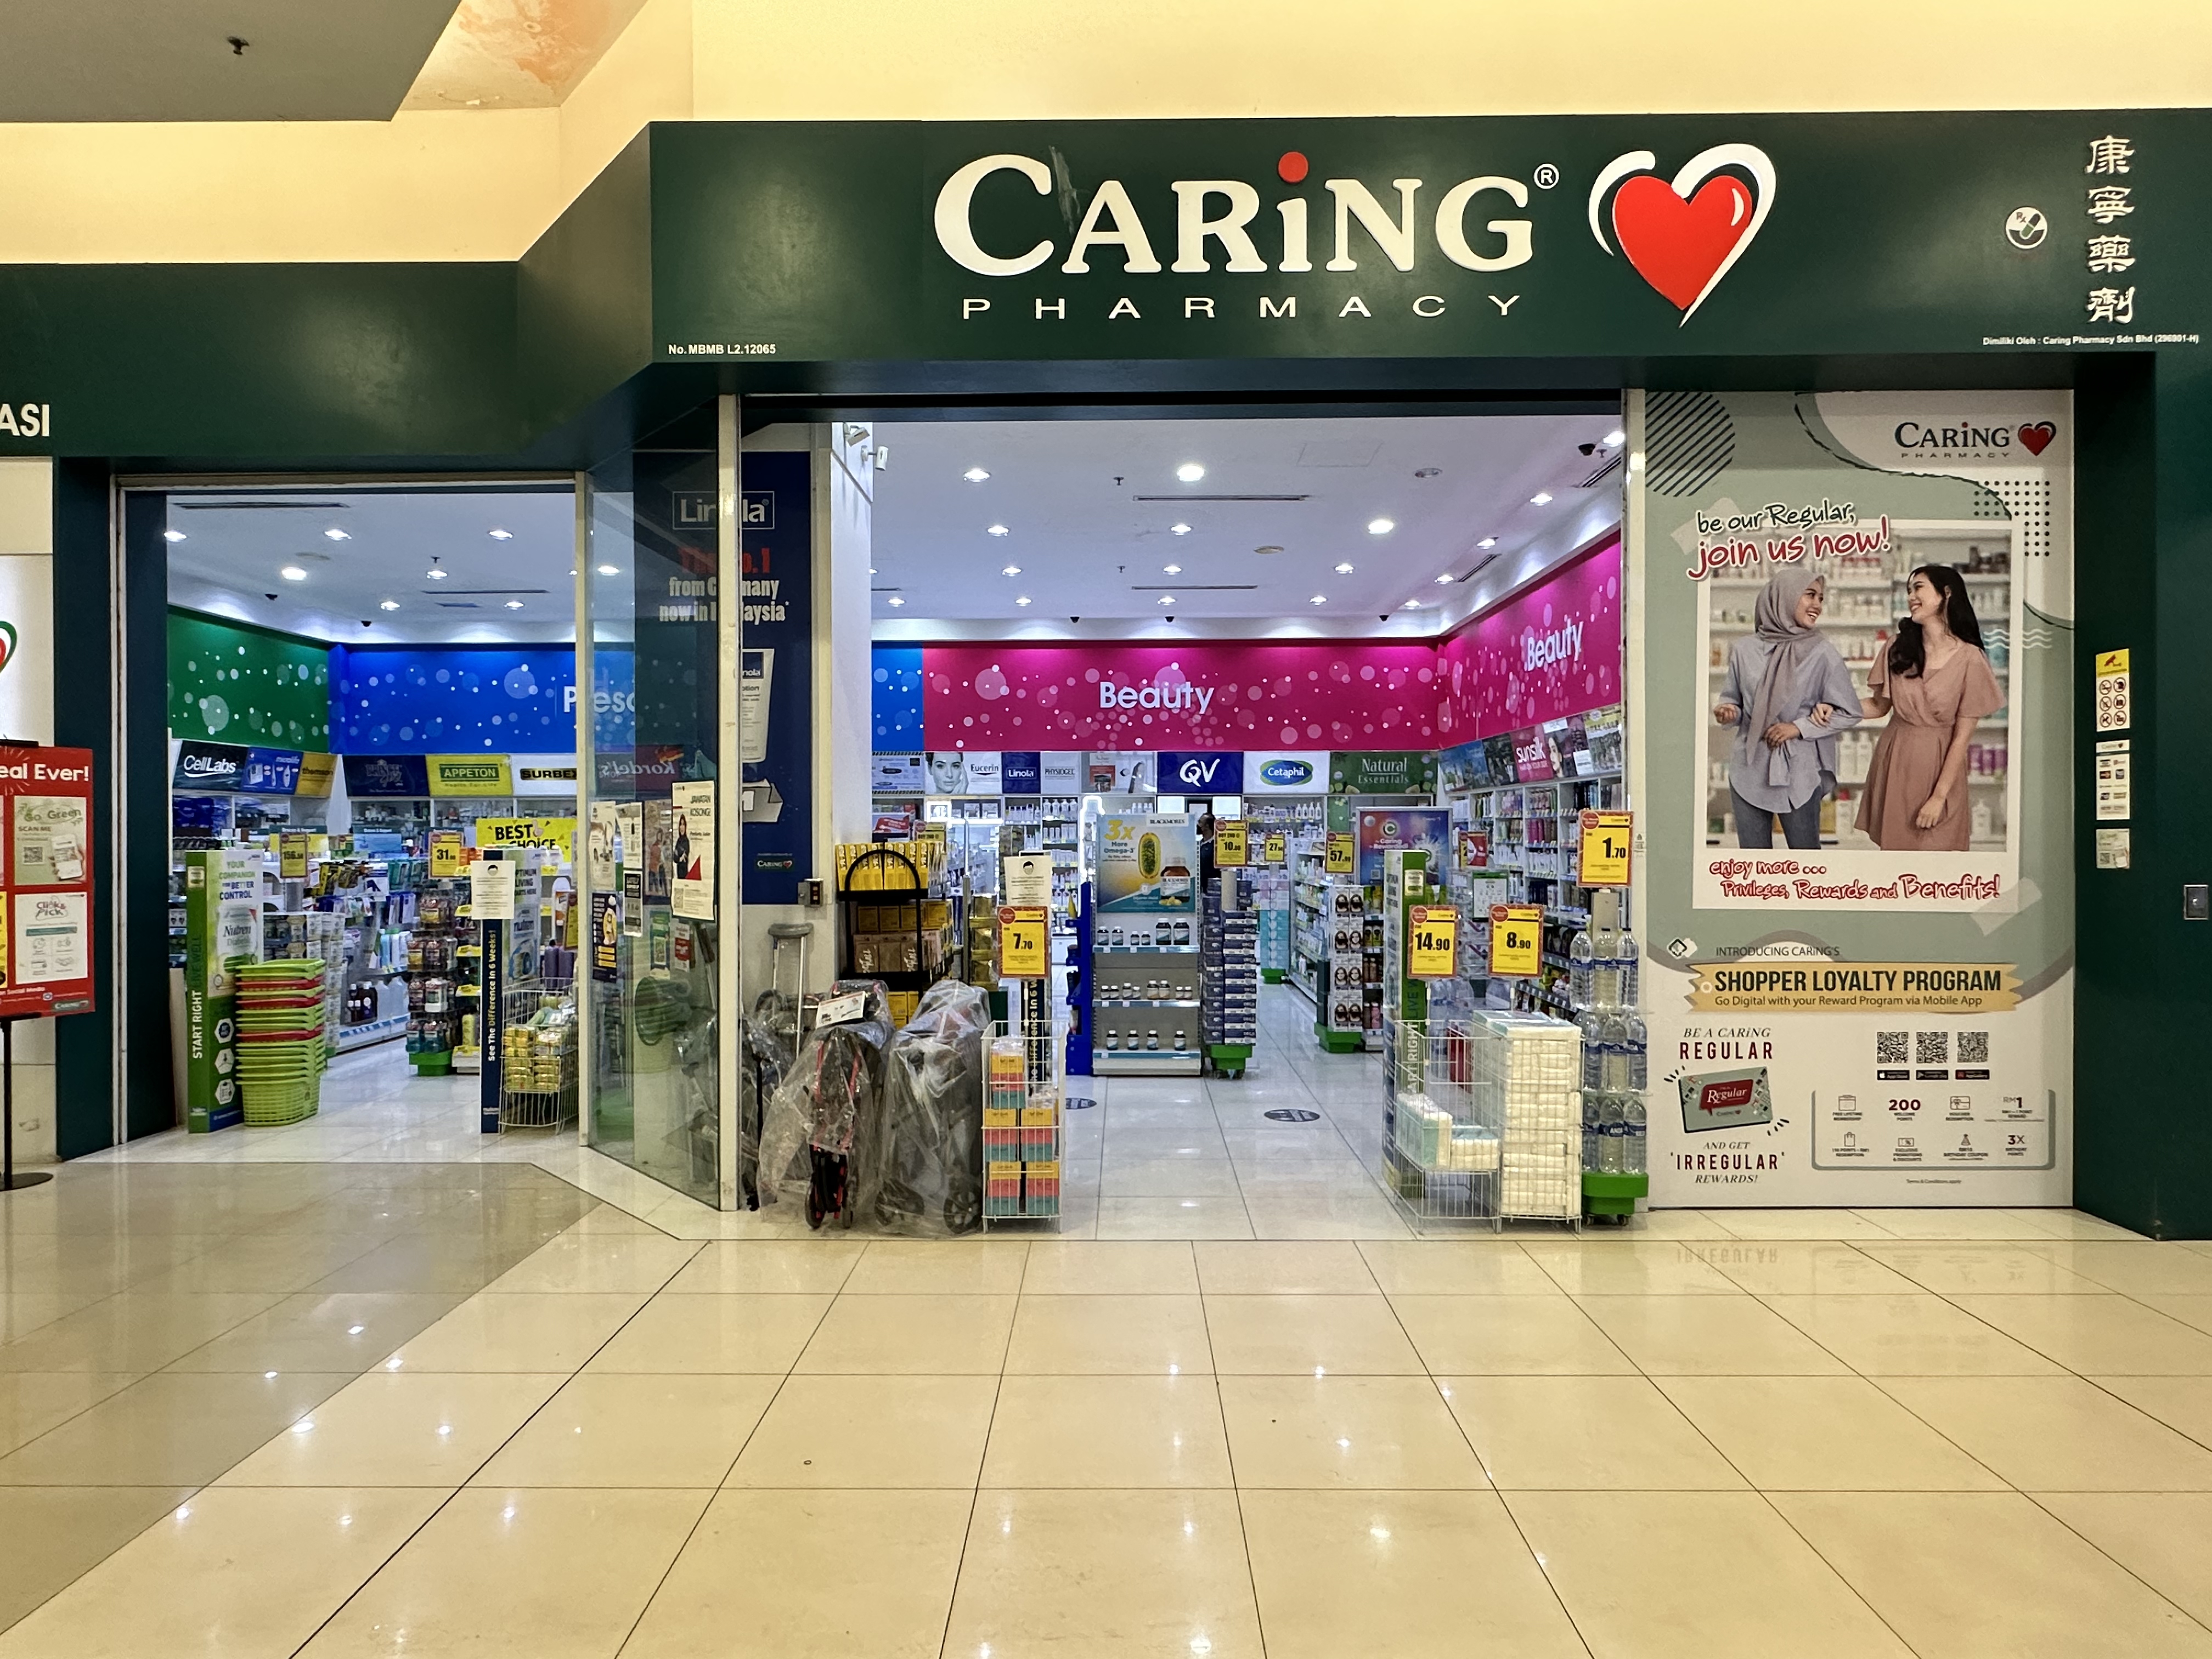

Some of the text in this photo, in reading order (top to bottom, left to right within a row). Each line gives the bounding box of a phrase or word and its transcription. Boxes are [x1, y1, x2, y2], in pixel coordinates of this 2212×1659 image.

[963, 295, 1521, 319] PHARMACY
[668, 344, 776, 354] No. MBMB L2.12065
[1983, 337, 2014, 345] Dimiliki
[2043, 336, 2070, 346] Caring
[2073, 335, 2114, 345] Pharmacy
[2117, 335, 2133, 343] Sdn
[2135, 335, 2153, 343] Bhd
[1697, 499, 1855, 533] be our Regular,
[1688, 516, 1890, 578] join us now!
[669, 577, 780, 600] from Gmany
[659, 601, 786, 625] now in aysia
[1527, 618, 1584, 672] Beauty
[1100, 681, 1215, 714] Beauty
[34, 764, 89, 781] Ever!
[444, 768, 496, 777] APPETON
[1180, 758, 1220, 787] QV
[1268, 766, 1305, 778] Cetaphil
[1362, 757, 1407, 772] Natural
[1358, 775, 1409, 783] Essentials
[24, 808, 81, 822] Go Green
[495, 824, 533, 840] BEST
[1104, 819, 1136, 840] 3x
[1602, 837, 1626, 859] 1.70
[1709, 859, 1753, 879] enjoy
[1756, 860, 1799, 874] more
[219, 890, 252, 900] CONTROL
[1720, 873, 2000, 900] Privileges, Rewards and Benefits!
[487, 930, 496, 962] Weeks!
[1013, 933, 1032, 950] 7.70
[1414, 932, 1450, 950] 14.90
[1506, 932, 1531, 949] 8.90
[1716, 946, 1789, 956] INTRODUCING
[487, 970, 496, 979] In
[1715, 970, 2001, 991] SHOPPER LOYALTY PROGRAM
[192, 990, 202, 1023] RIGHT
[487, 980, 496, 1026] Difference
[1715, 995, 1983, 1008] Go Digital with your Reward Program via Mobile App
[487, 1028, 496, 1044] The
[1684, 1028, 1701, 1038] BE
[1704, 1028, 1713, 1038] A
[192, 1025, 202, 1059] START
[1680, 1042, 1773, 1059] REGULAR
[487, 1045, 496, 1062] See
[1707, 1088, 1747, 1105] Regular
[1888, 1099, 1921, 1111] 200
[1729, 1141, 1751, 1149] GET
[2008, 1135, 2025, 1145] 3X
[1695, 1174, 1759, 1184] REWARDS!
